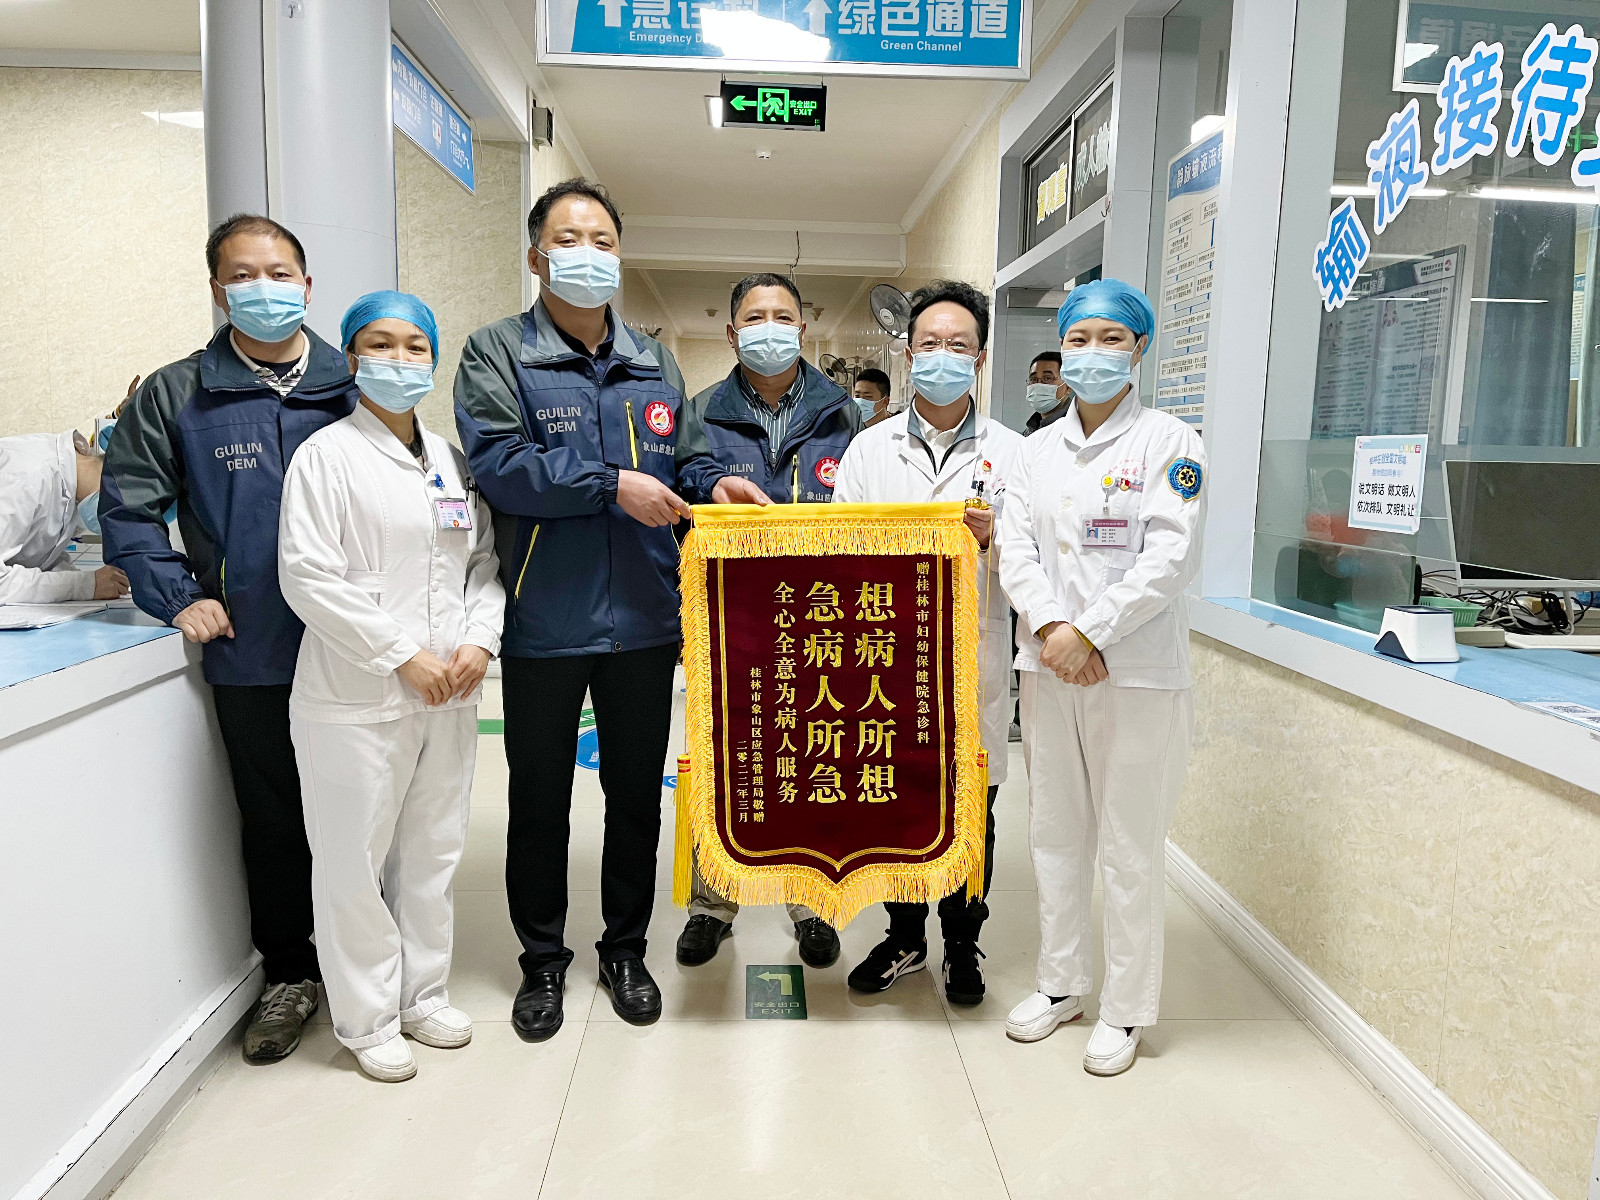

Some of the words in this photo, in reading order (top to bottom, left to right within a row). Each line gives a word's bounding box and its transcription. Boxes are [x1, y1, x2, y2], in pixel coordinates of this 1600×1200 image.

[838, 0, 1008, 38] 绿色通道
[629, 31, 692, 45] Emergency
[880, 39, 914, 50] Green
[916, 40, 962, 51] Channel
[789, 100, 817, 109] 安全出口
[793, 108, 813, 116] EXIT
[1315, 32, 1600, 305] 输液接待
[536, 406, 581, 420] GUILIN
[547, 421, 577, 434] DEM
[214, 442, 263, 459] GUILIN
[226, 457, 258, 472] DEM
[725, 463, 754, 473] UILIN
[1358, 482, 1385, 496] 说文明话
[1387, 484, 1416, 498] 做文明人
[1356, 501, 1383, 515] 依次排队
[1386, 503, 1415, 517] 文明礼让
[773, 581, 798, 803] 全心全意为病人服务
[803, 581, 847, 804] 急病人所急
[854, 581, 898, 803] 想病人所想
[749, 667, 765, 823] 桂林市象山区应急管理局敬赠
[736, 740, 749, 823] 二零二二年三月
